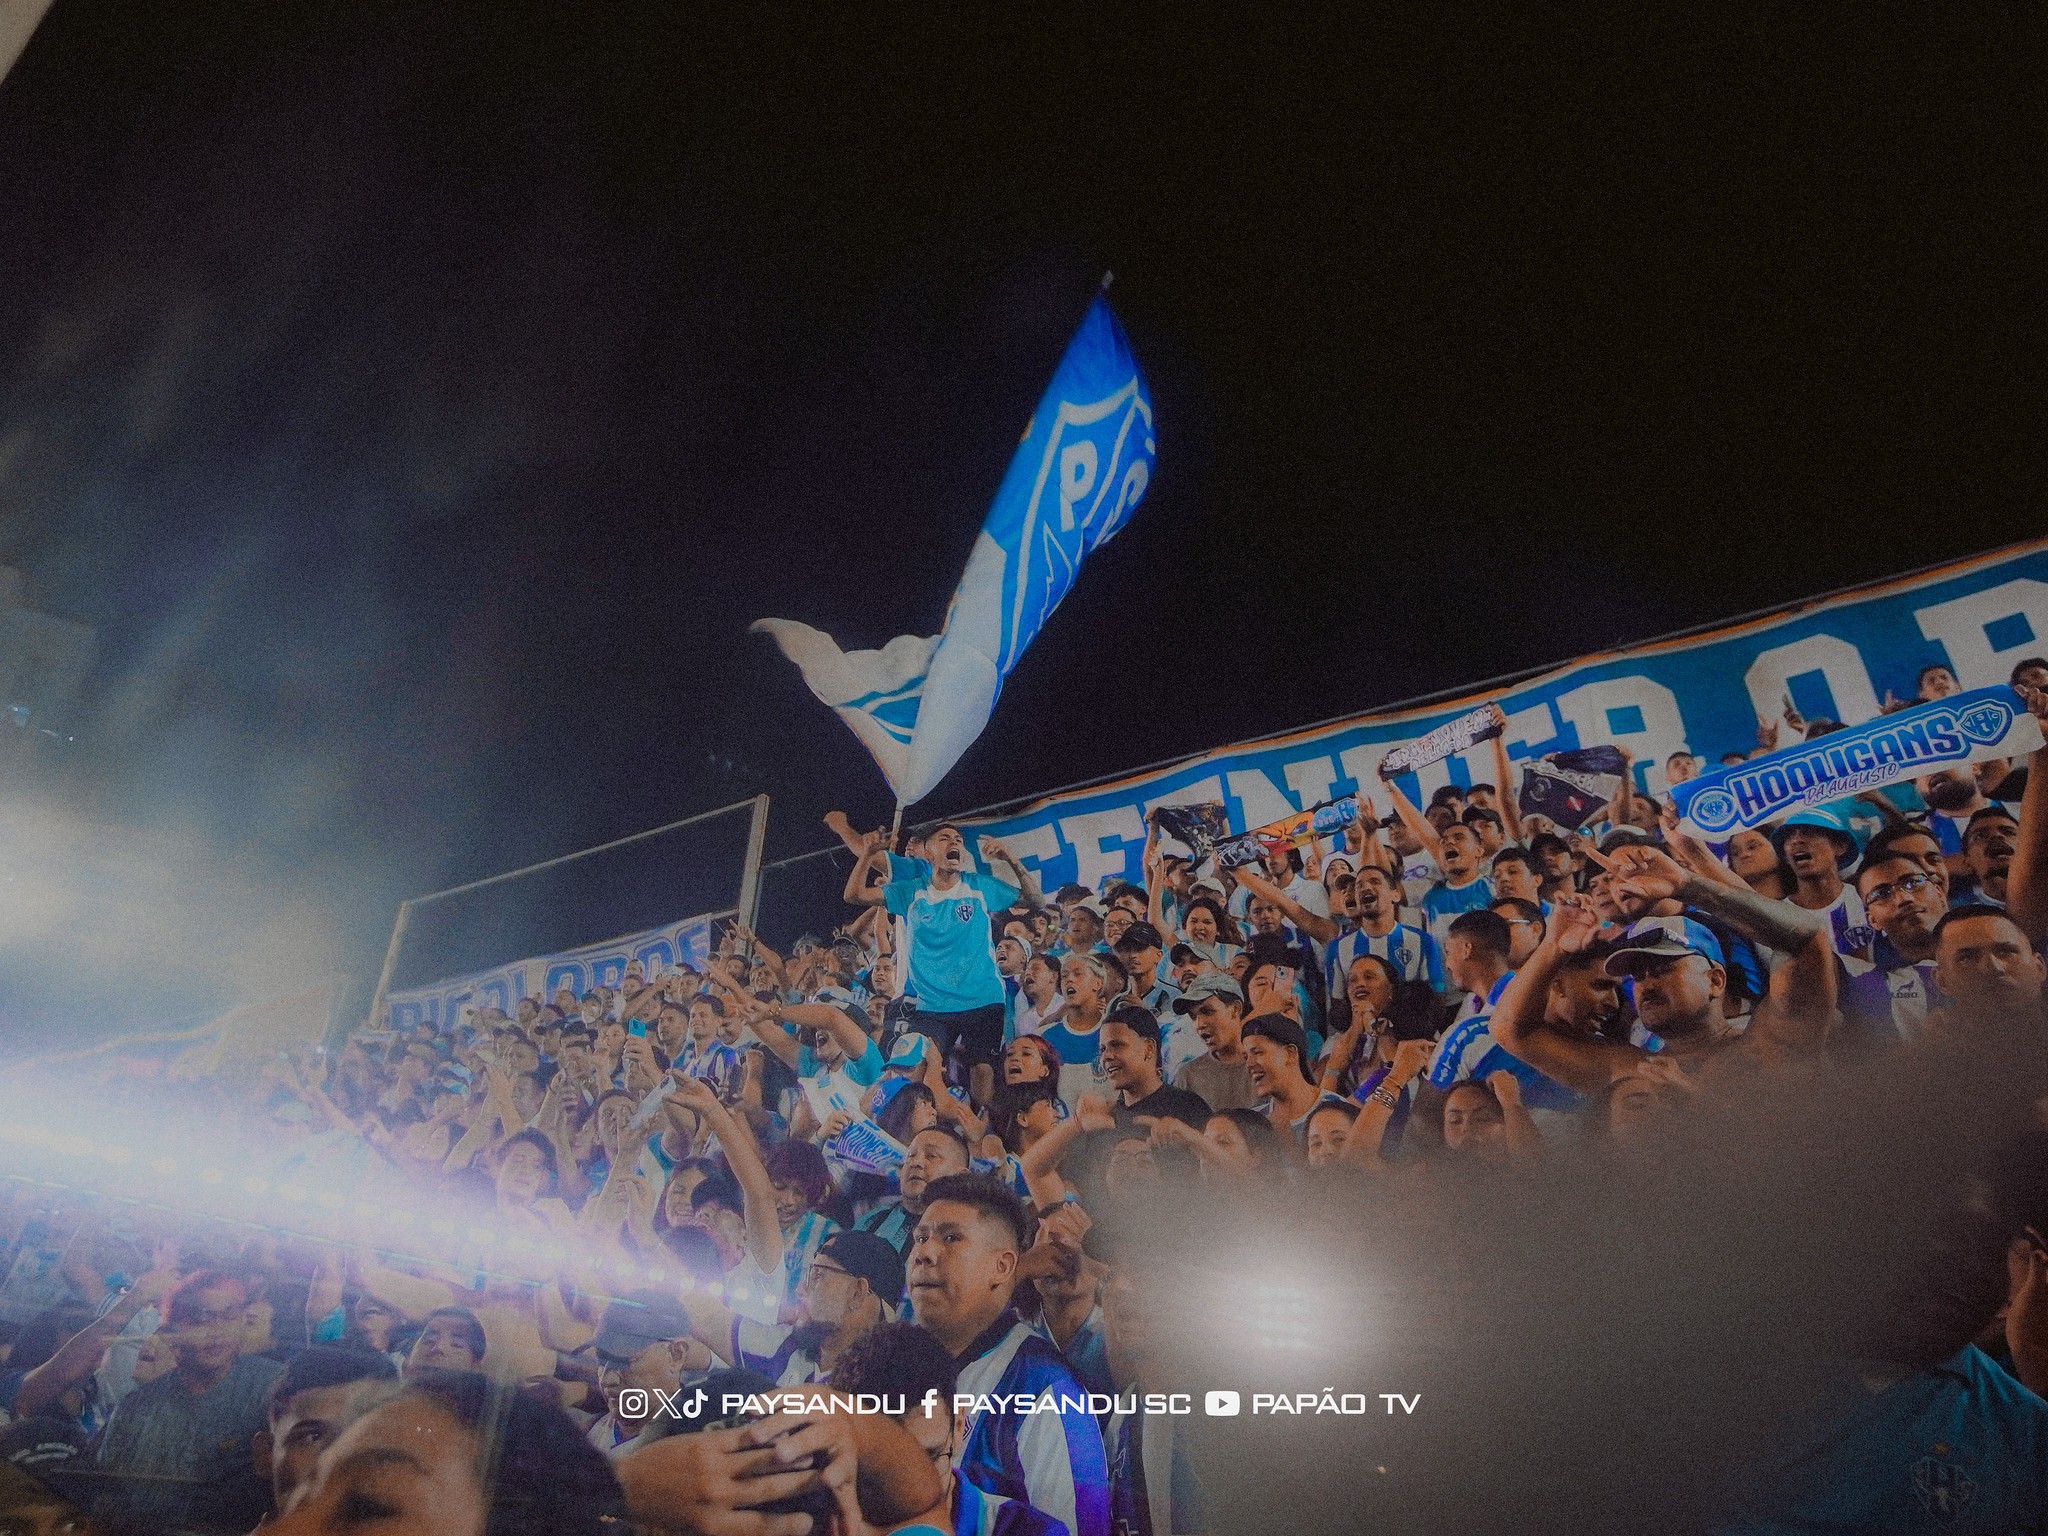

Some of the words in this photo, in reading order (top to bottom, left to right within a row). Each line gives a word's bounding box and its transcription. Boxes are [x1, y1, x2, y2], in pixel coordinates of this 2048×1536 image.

[1734, 717, 1963, 815] HOOLIGANS
[1804, 783, 1825, 806] DA
[1825, 762, 1900, 799] AUGUSTO
